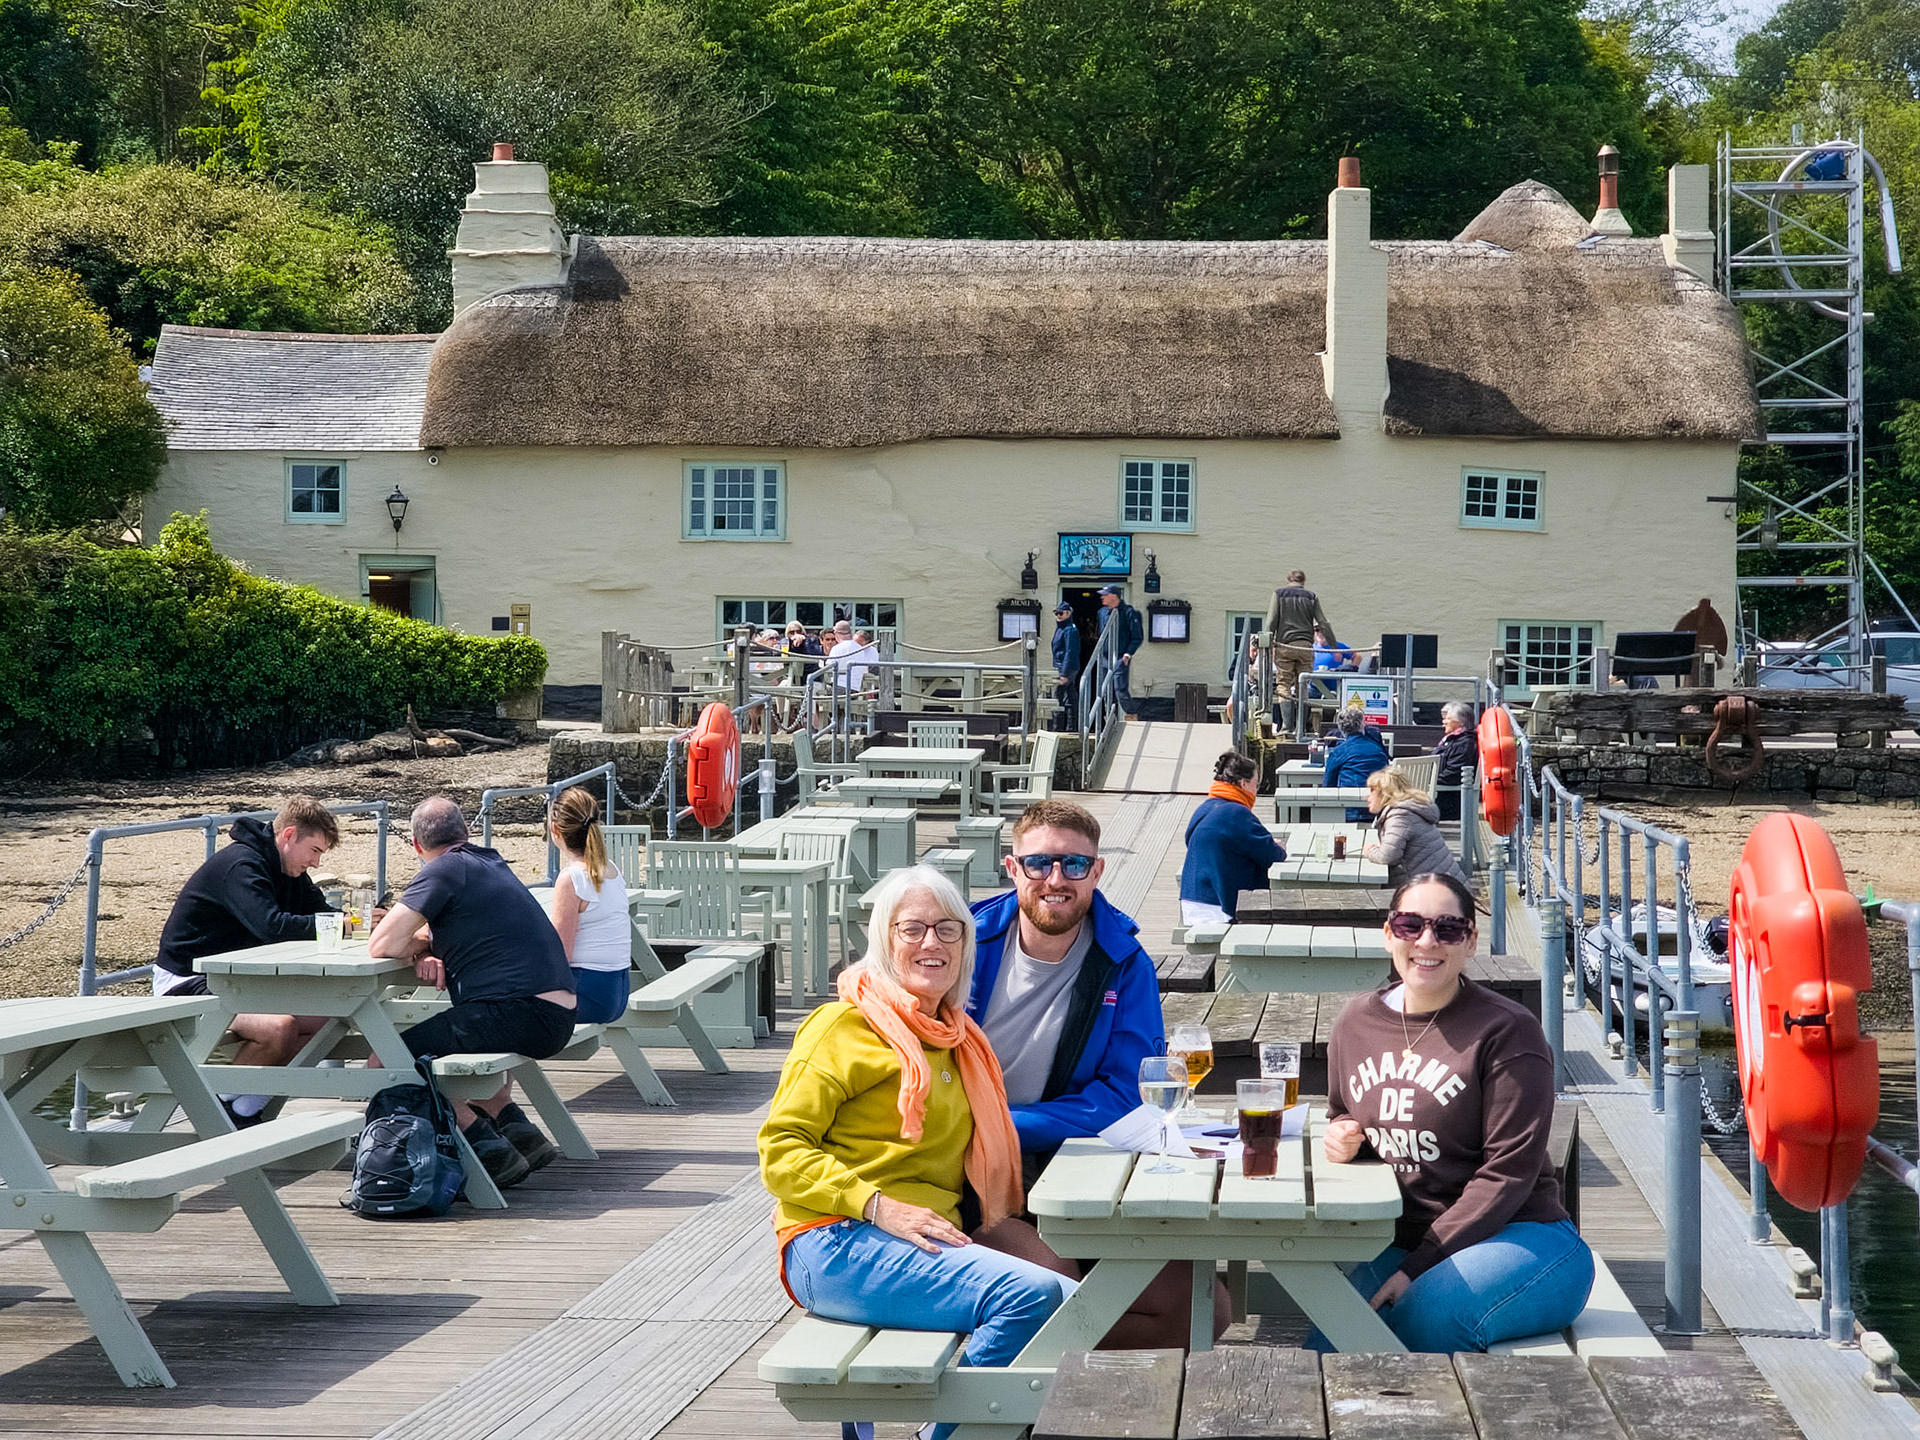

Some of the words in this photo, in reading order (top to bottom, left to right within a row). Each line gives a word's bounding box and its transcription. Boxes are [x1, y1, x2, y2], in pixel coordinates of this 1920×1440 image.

[1073, 538, 1117, 549] PANDORA
[1349, 1052, 1467, 1106] CHARME
[1379, 1087, 1415, 1122] DE
[1366, 1127, 1440, 1162] PARIS
[1393, 1163, 1420, 1173] 1998
